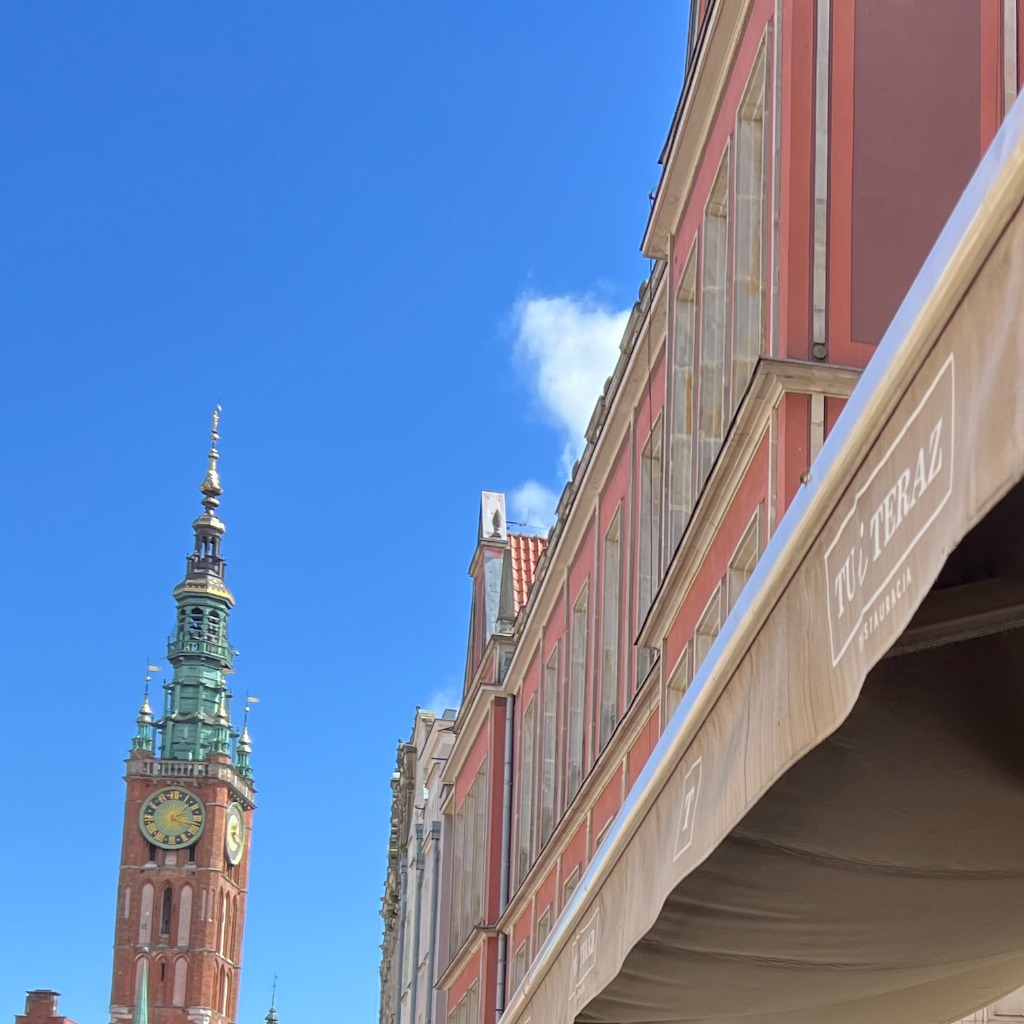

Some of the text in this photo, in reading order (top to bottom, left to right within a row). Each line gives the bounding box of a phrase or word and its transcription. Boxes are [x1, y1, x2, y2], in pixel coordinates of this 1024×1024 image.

[834, 417, 943, 619] TU i TERAZ
